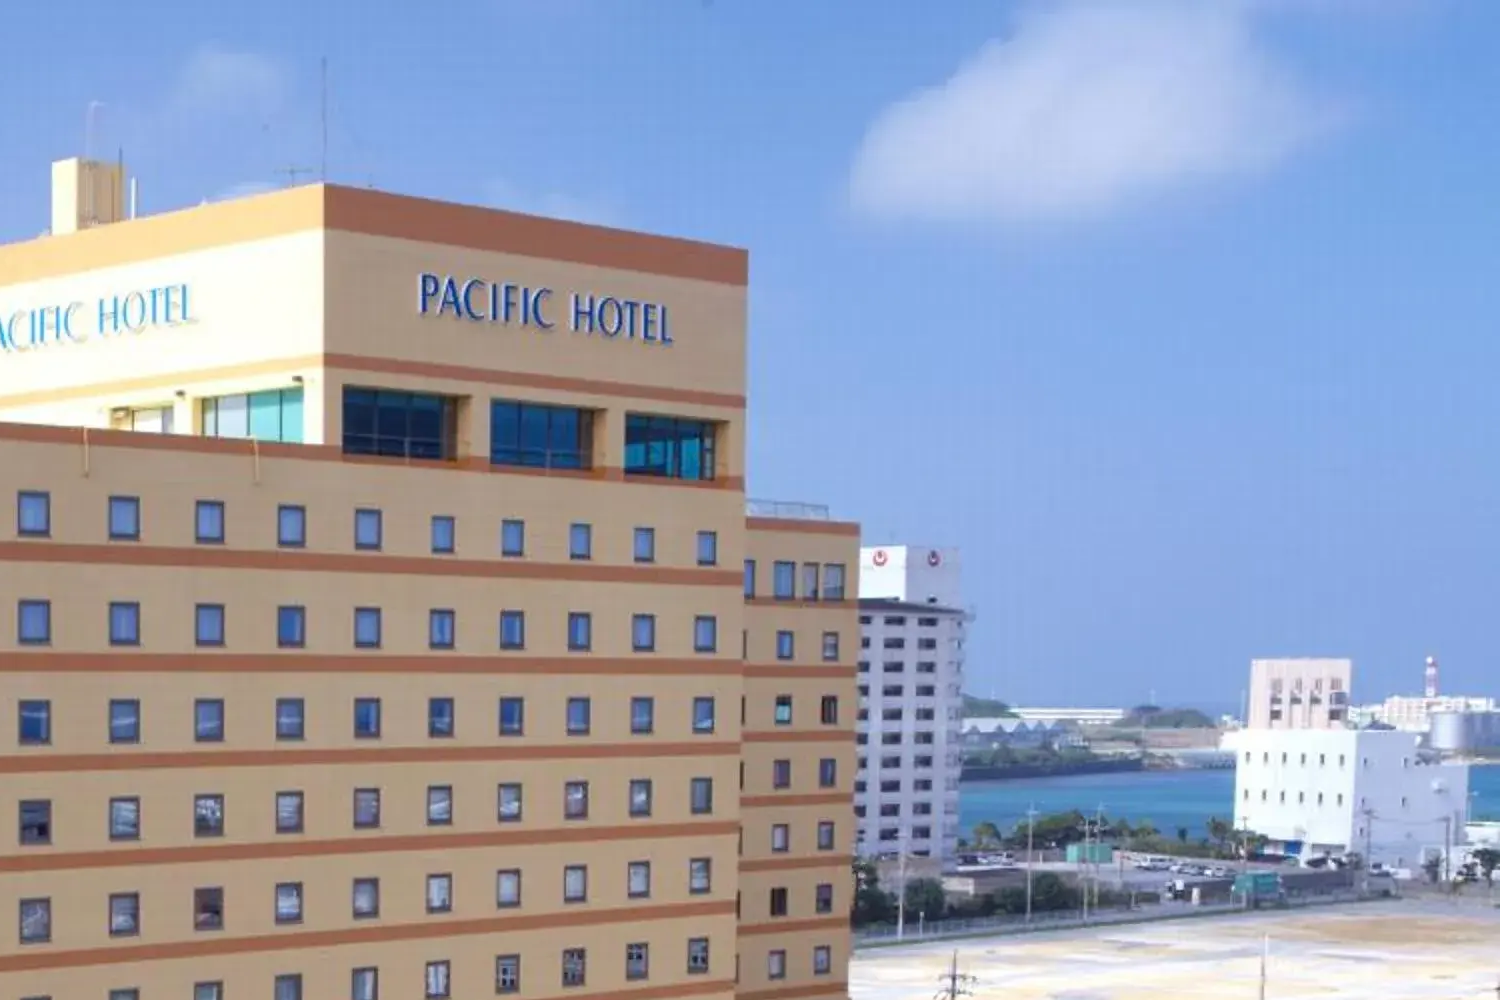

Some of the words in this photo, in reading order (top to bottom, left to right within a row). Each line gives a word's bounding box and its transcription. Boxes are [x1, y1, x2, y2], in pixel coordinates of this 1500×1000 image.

[99, 284, 197, 335] HOTEL
[417, 272, 555, 329] PACIFIC
[569, 291, 674, 345] HOTEL
